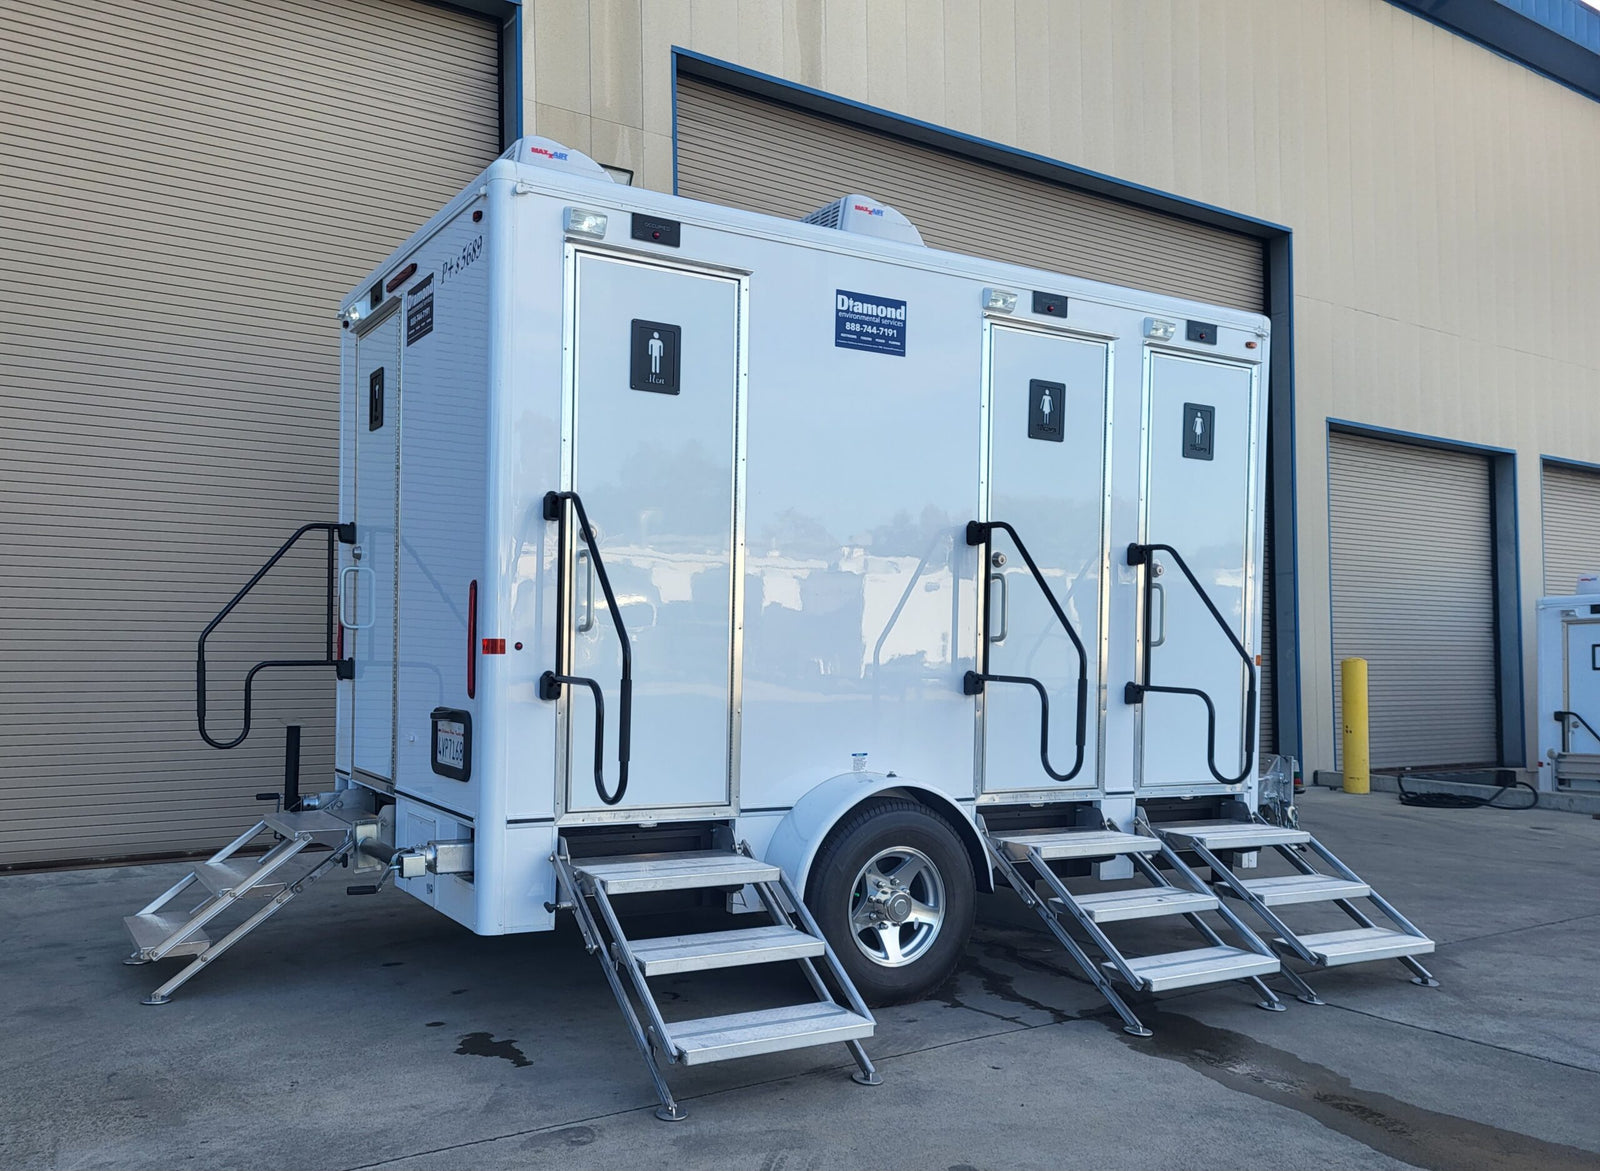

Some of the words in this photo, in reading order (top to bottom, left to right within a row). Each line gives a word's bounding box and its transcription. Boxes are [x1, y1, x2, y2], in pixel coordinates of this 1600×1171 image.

[837, 294, 905, 320] Diamond
[838, 312, 880, 323] environmental
[881, 319, 904, 327] services
[845, 322, 897, 337] 888-744-7191
